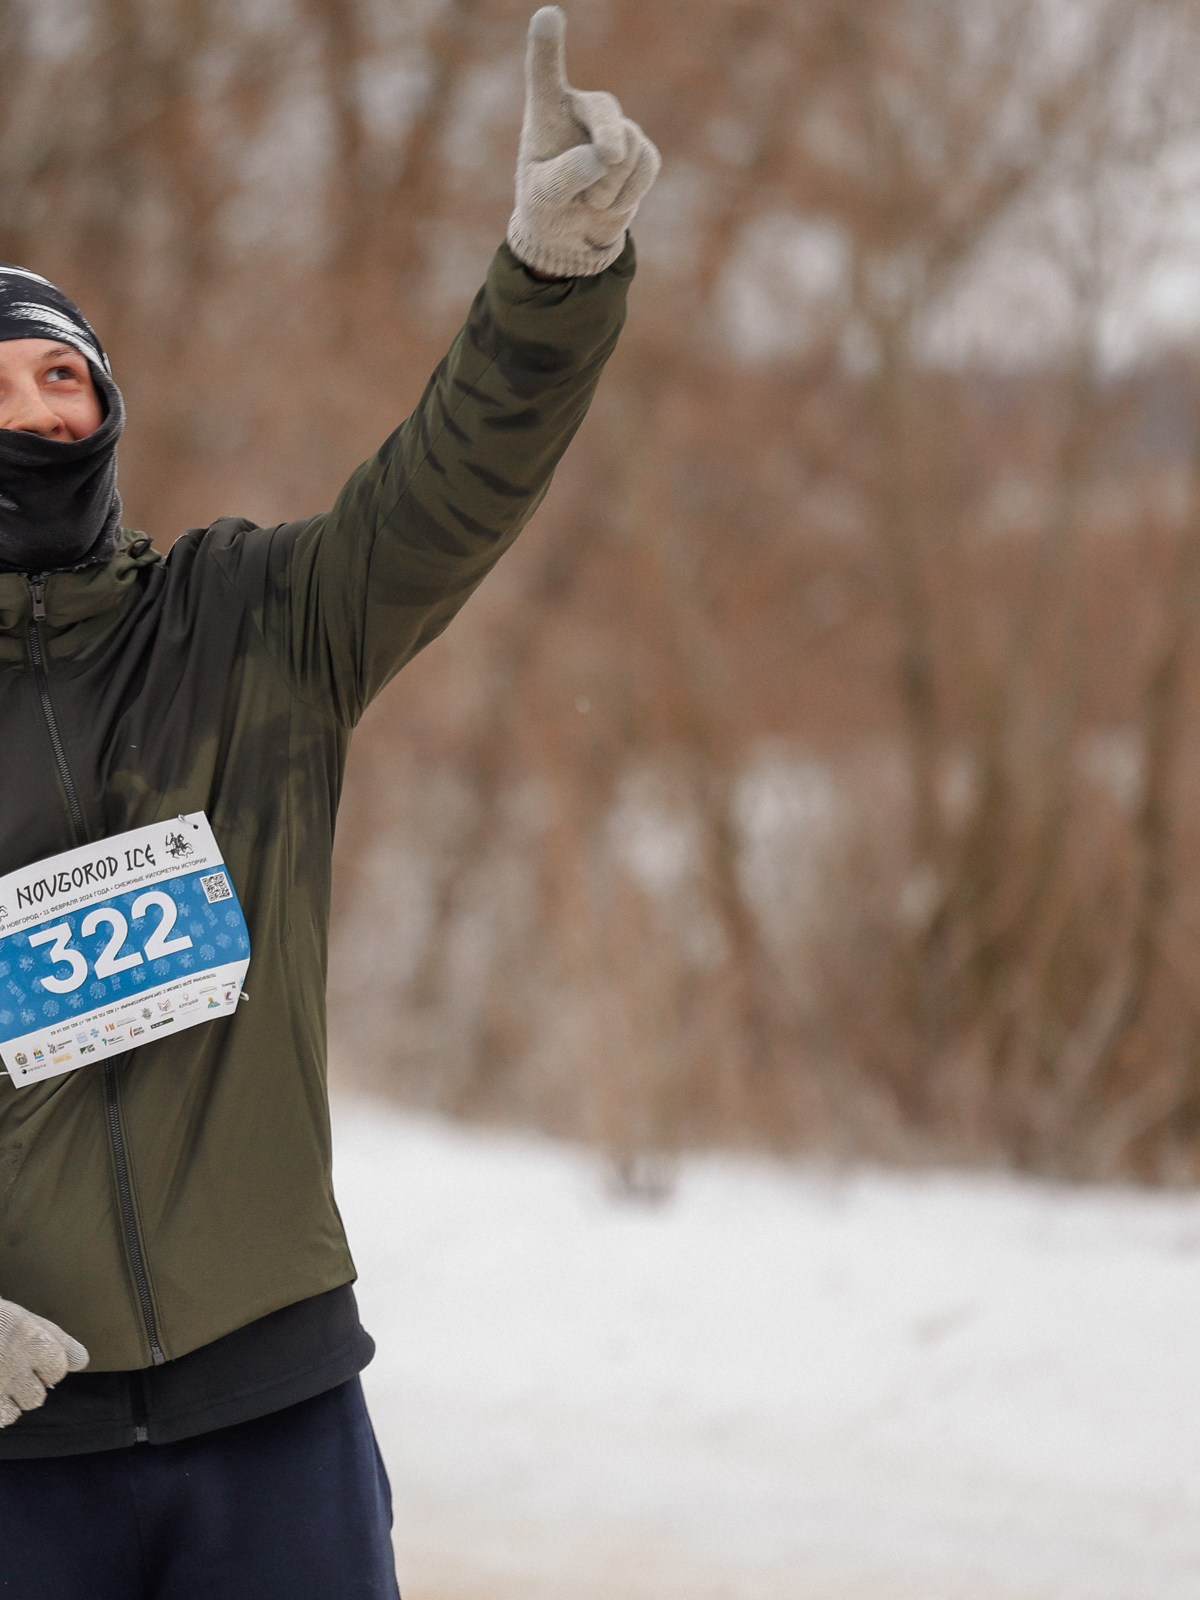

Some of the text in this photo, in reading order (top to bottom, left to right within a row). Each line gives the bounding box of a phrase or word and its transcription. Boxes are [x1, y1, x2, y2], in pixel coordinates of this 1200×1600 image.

[5, 912, 39, 929] НОВГОРОД
[50, 897, 78, 912] ФЕВРАЛЯ
[78, 892, 94, 902] 2024
[92, 887, 109, 897] ГОДА
[113, 875, 145, 890] СНЕЖНЫЕ
[144, 864, 180, 879] КИЛОМЕТРЫ
[180, 856, 207, 869] ИСТОРИИ
[16, 844, 156, 910] NOVGOROD ICE
[28, 891, 193, 994] 322
